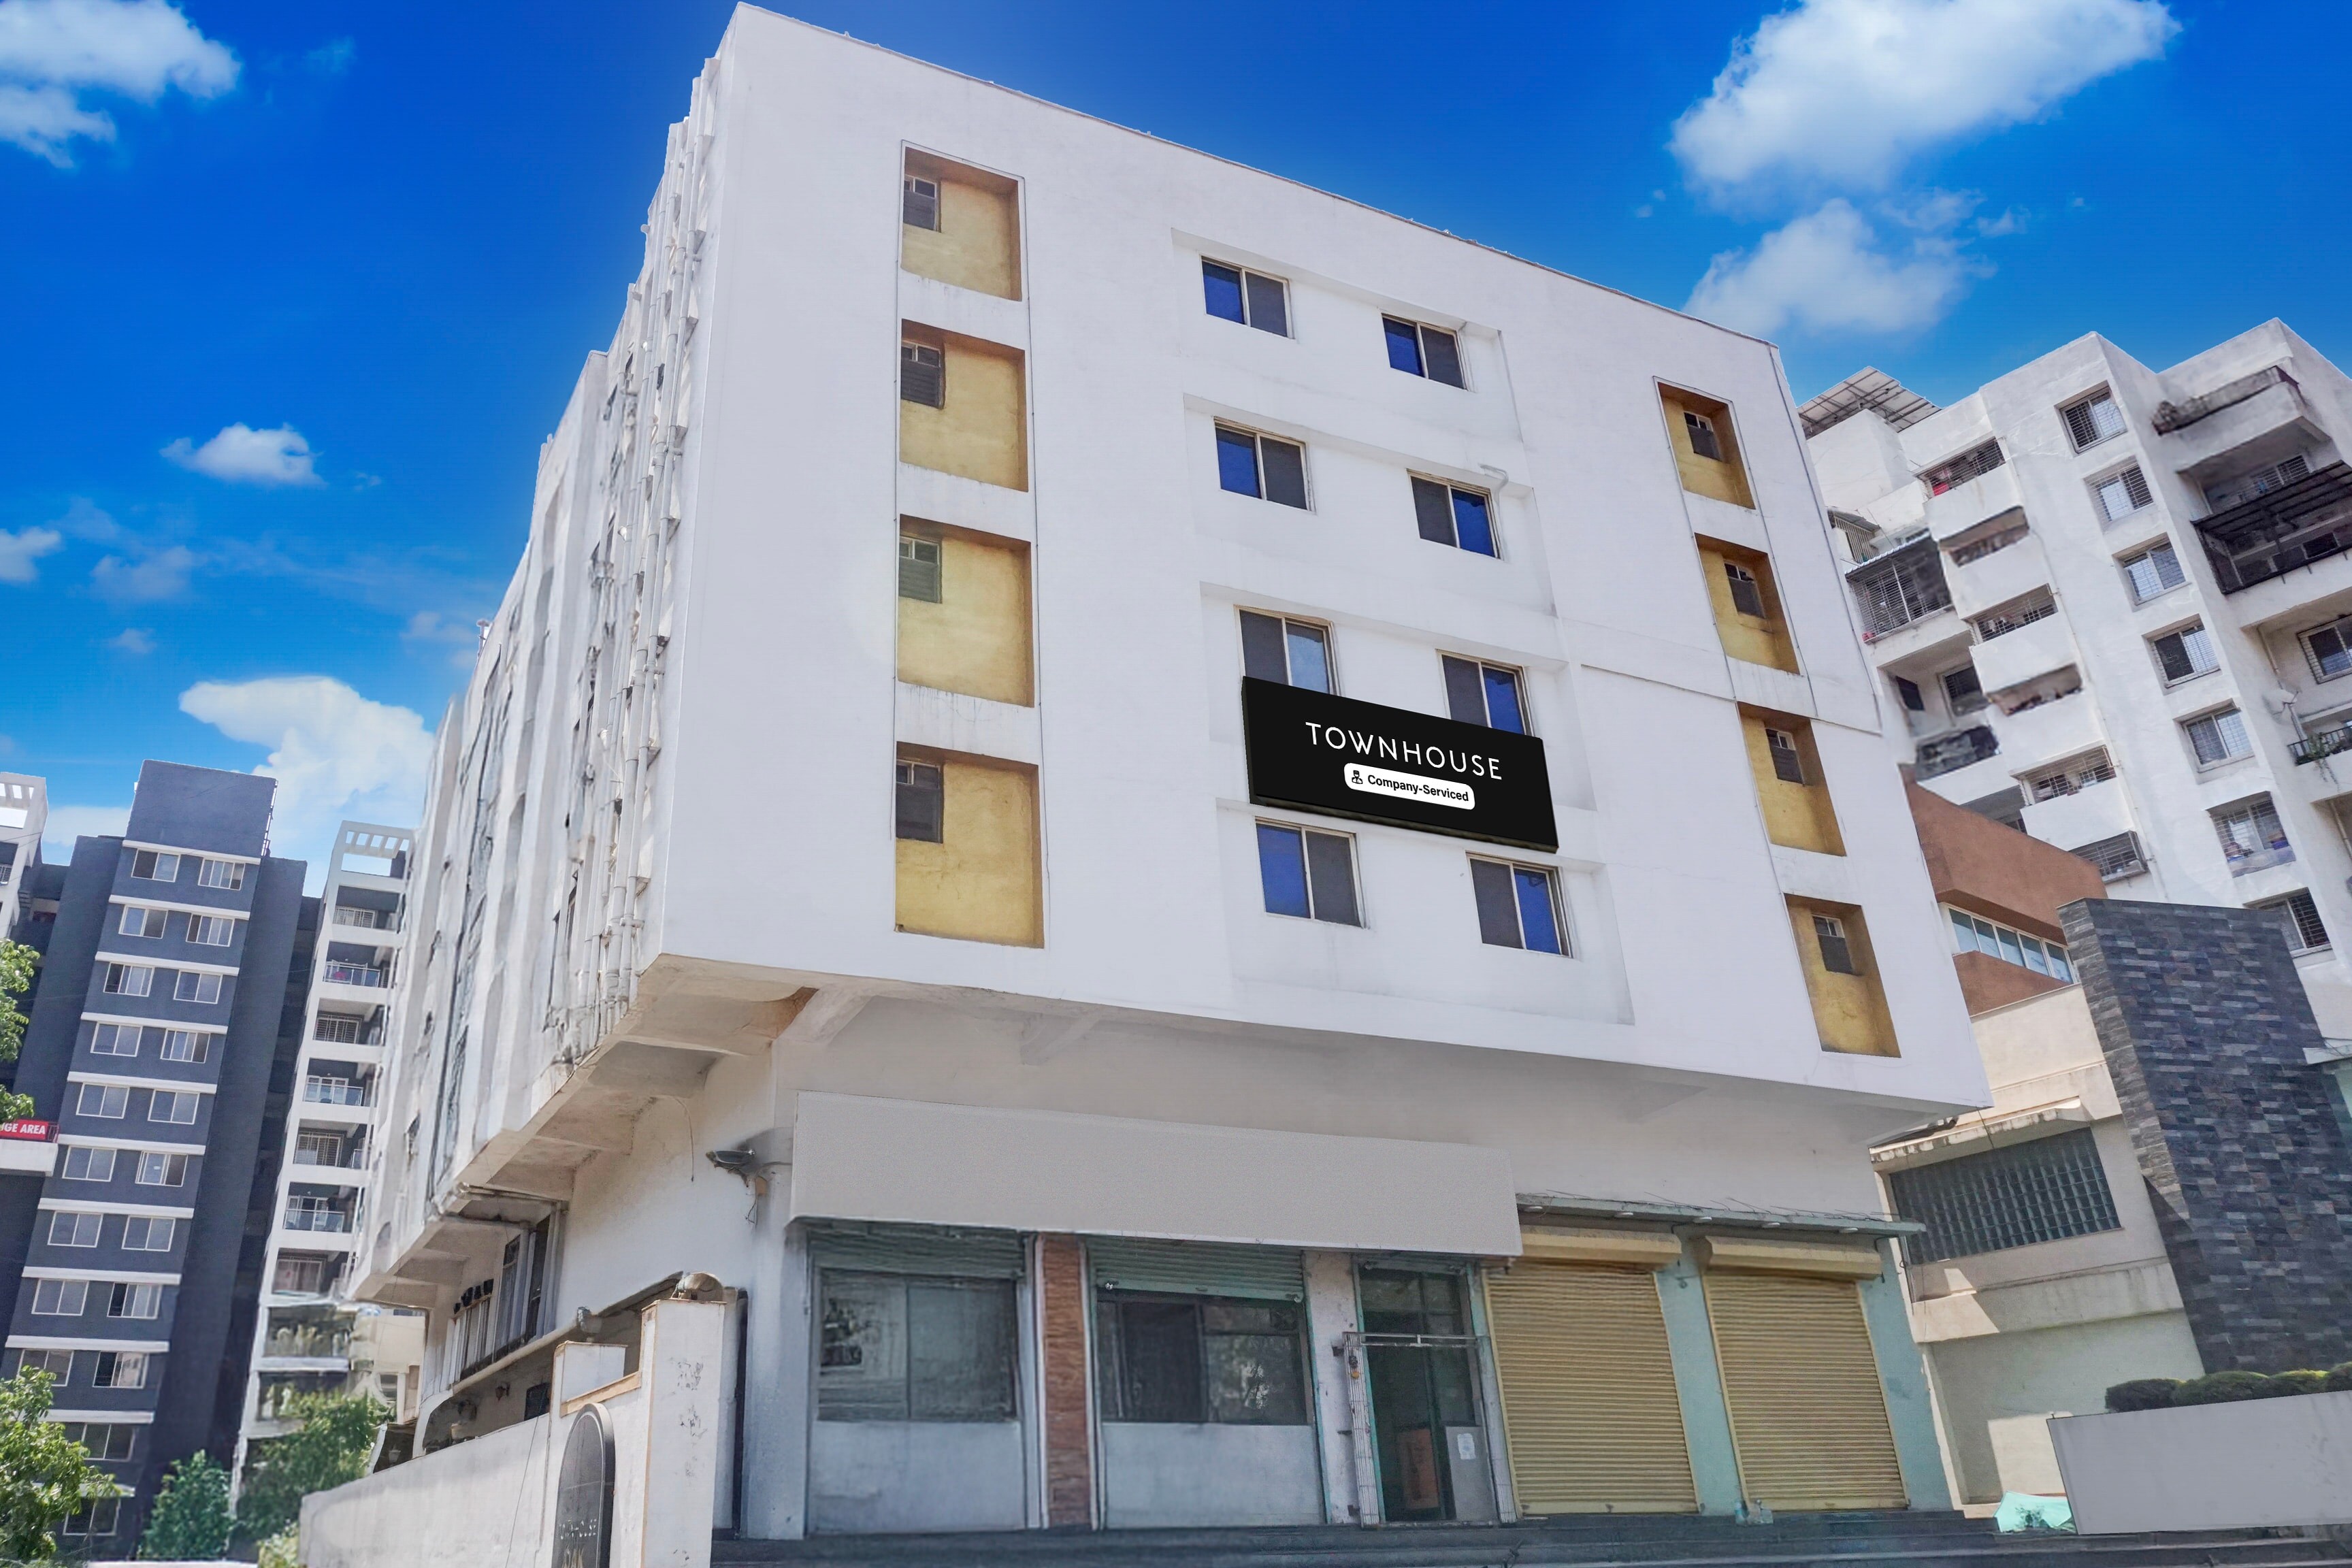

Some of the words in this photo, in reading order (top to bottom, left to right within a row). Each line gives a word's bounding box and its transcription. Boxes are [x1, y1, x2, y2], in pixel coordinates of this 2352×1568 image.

[1305, 721, 1502, 780] TOWNHOUSE
[1367, 774, 1469, 802] Company-Serviced
[20, 1124, 46, 1134] AREA
